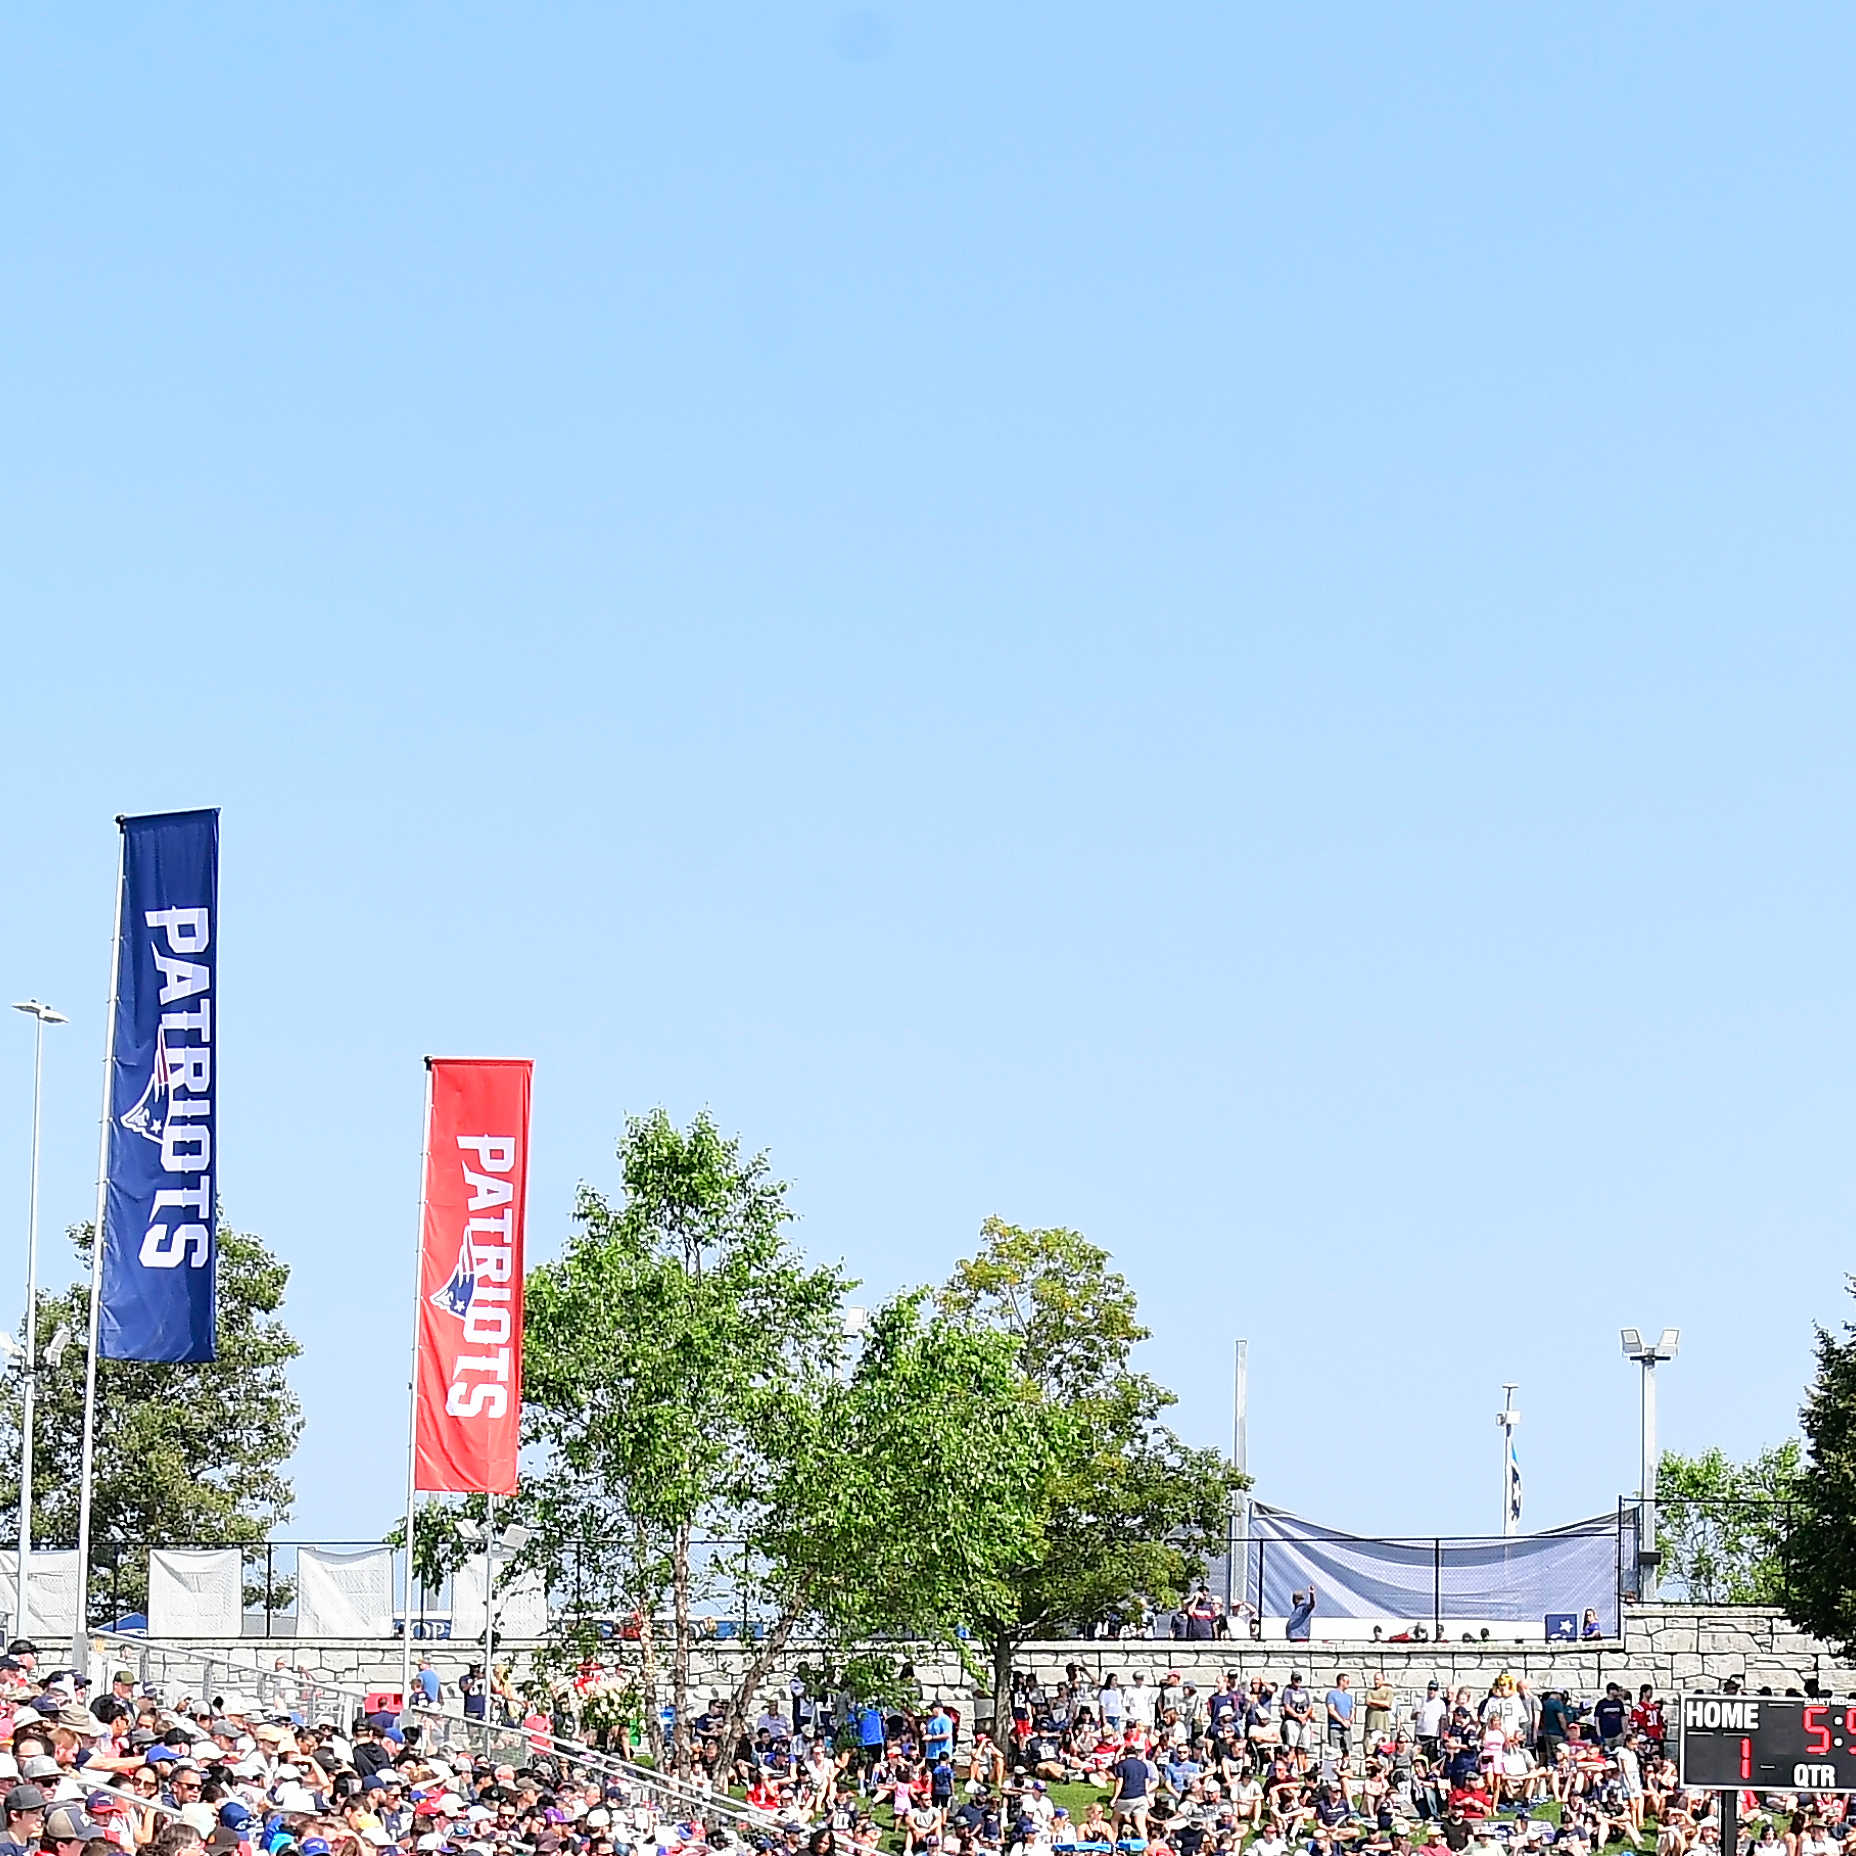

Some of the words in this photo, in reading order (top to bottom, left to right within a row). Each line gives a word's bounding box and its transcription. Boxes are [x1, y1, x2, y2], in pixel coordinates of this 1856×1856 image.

[138, 904, 211, 1269] PATRIOTS
[445, 1134, 516, 1420] PATRIOTS
[1685, 1701, 1760, 1729] HOME
[1739, 1737, 1753, 1781] 1
[1793, 1762, 1837, 1788] QTR
